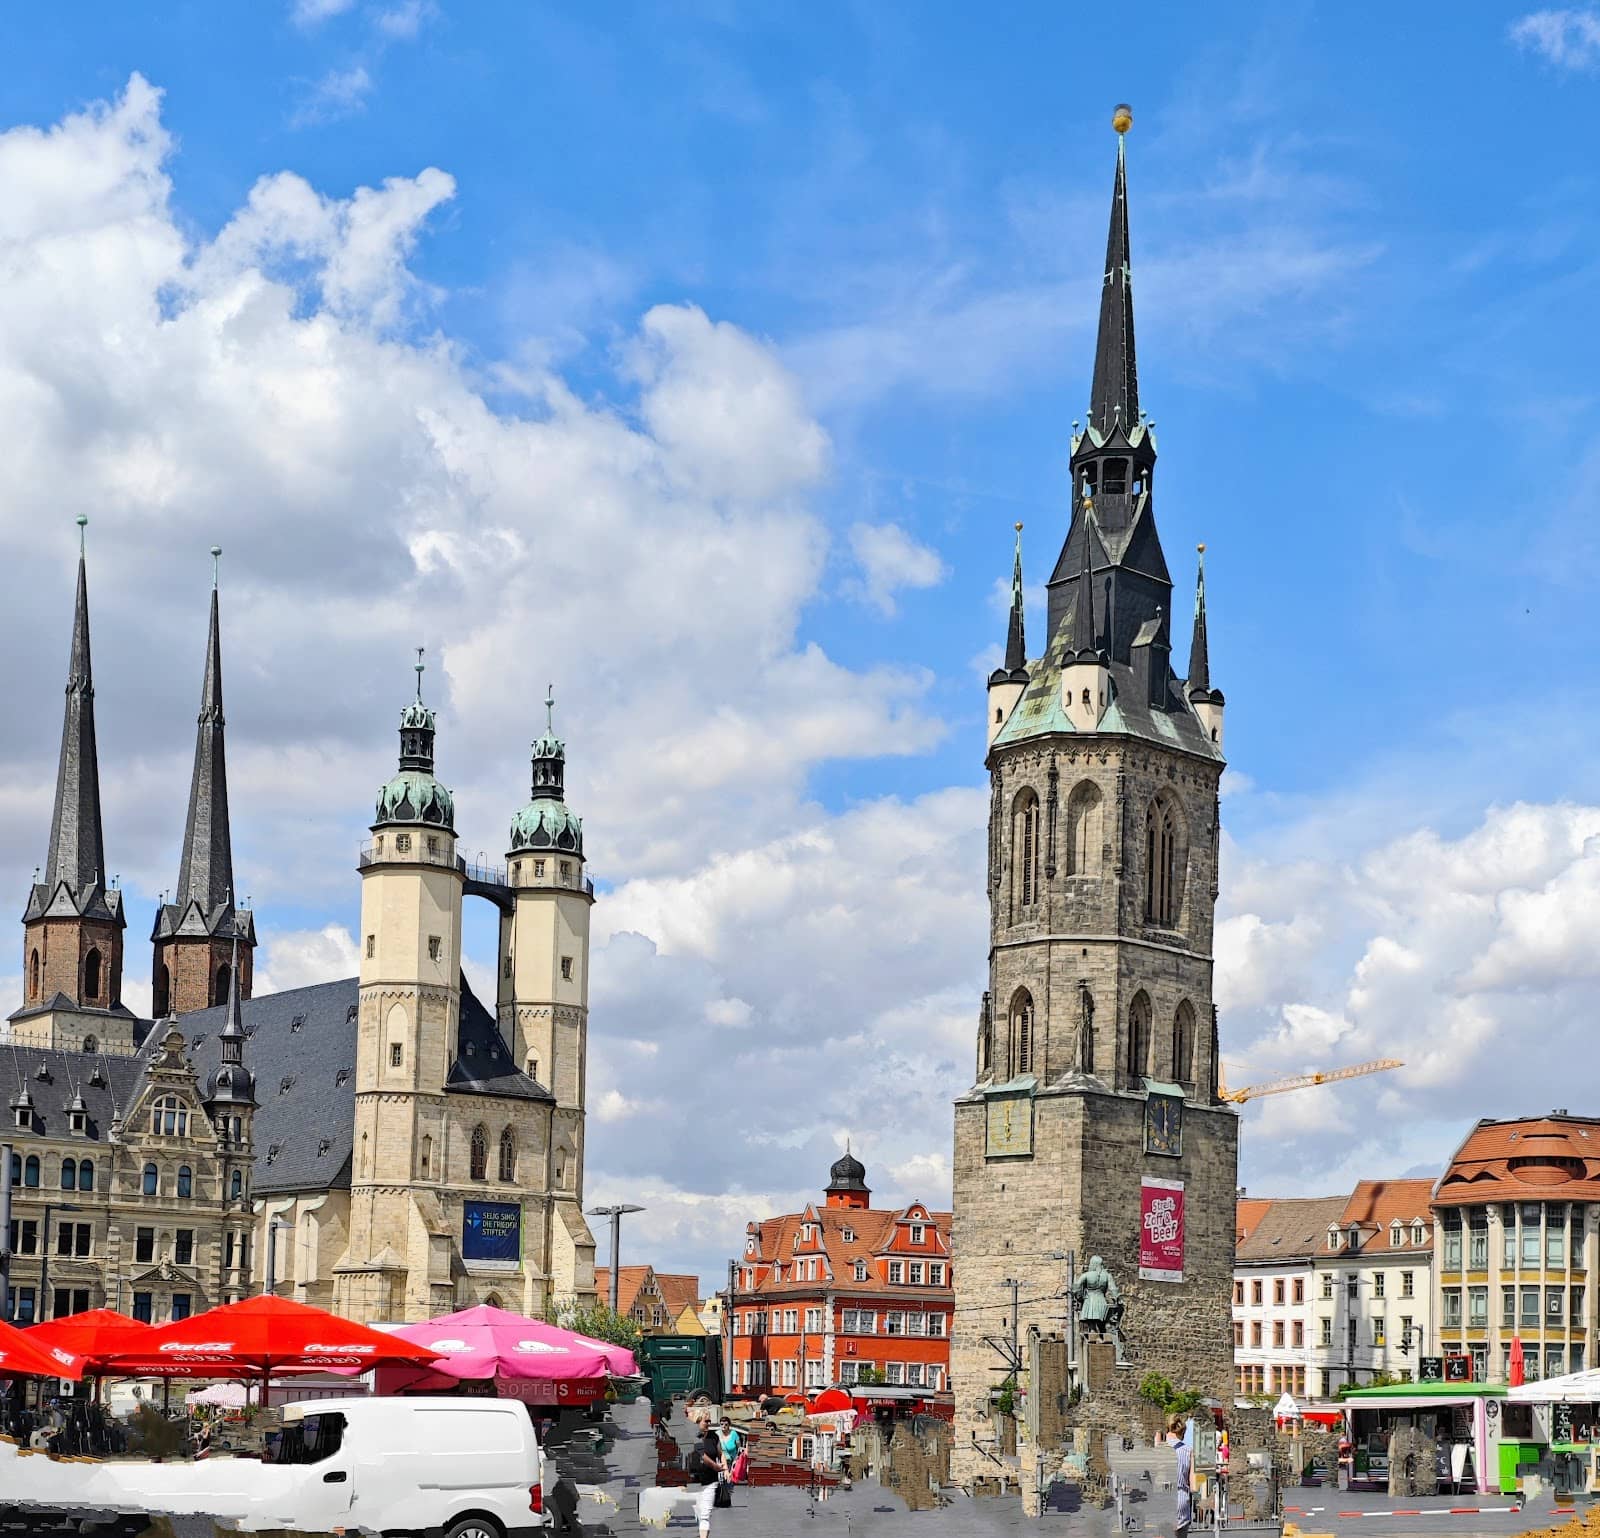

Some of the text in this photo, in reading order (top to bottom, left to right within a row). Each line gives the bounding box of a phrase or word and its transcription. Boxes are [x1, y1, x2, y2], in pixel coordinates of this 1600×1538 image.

[482, 1212, 500, 1220] SELIG
[482, 1220, 493, 1228] DIE
[1152, 1221, 1177, 1242] Beef
[159, 1343, 235, 1351] Coca-Cola
[304, 1344, 376, 1352] Coca-Cola
[498, 1383, 569, 1396] SOFTEIS
